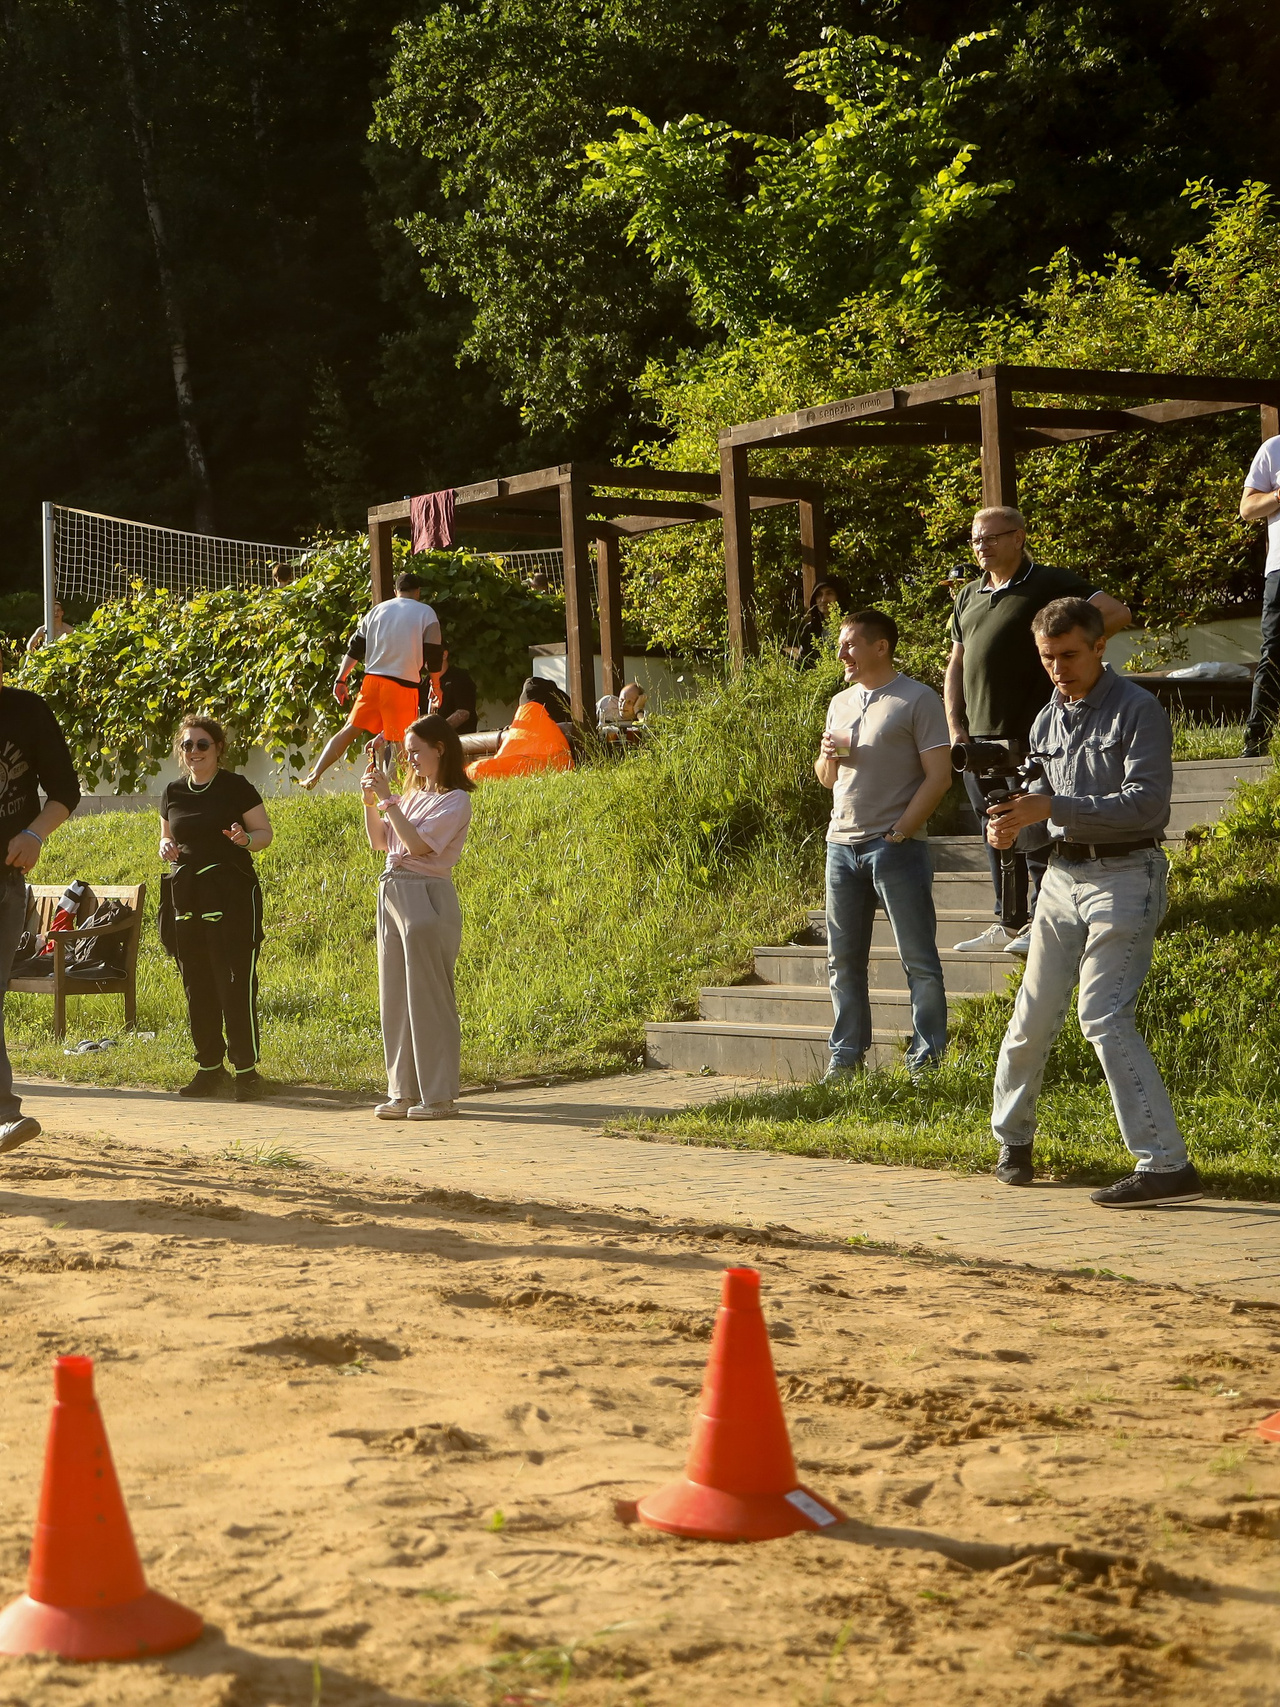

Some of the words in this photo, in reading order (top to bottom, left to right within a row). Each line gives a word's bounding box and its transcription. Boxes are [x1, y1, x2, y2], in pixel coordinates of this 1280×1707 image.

[819, 402, 856, 419] segezha
[860, 398, 881, 411] group
[7, 795, 27, 815] CITY
